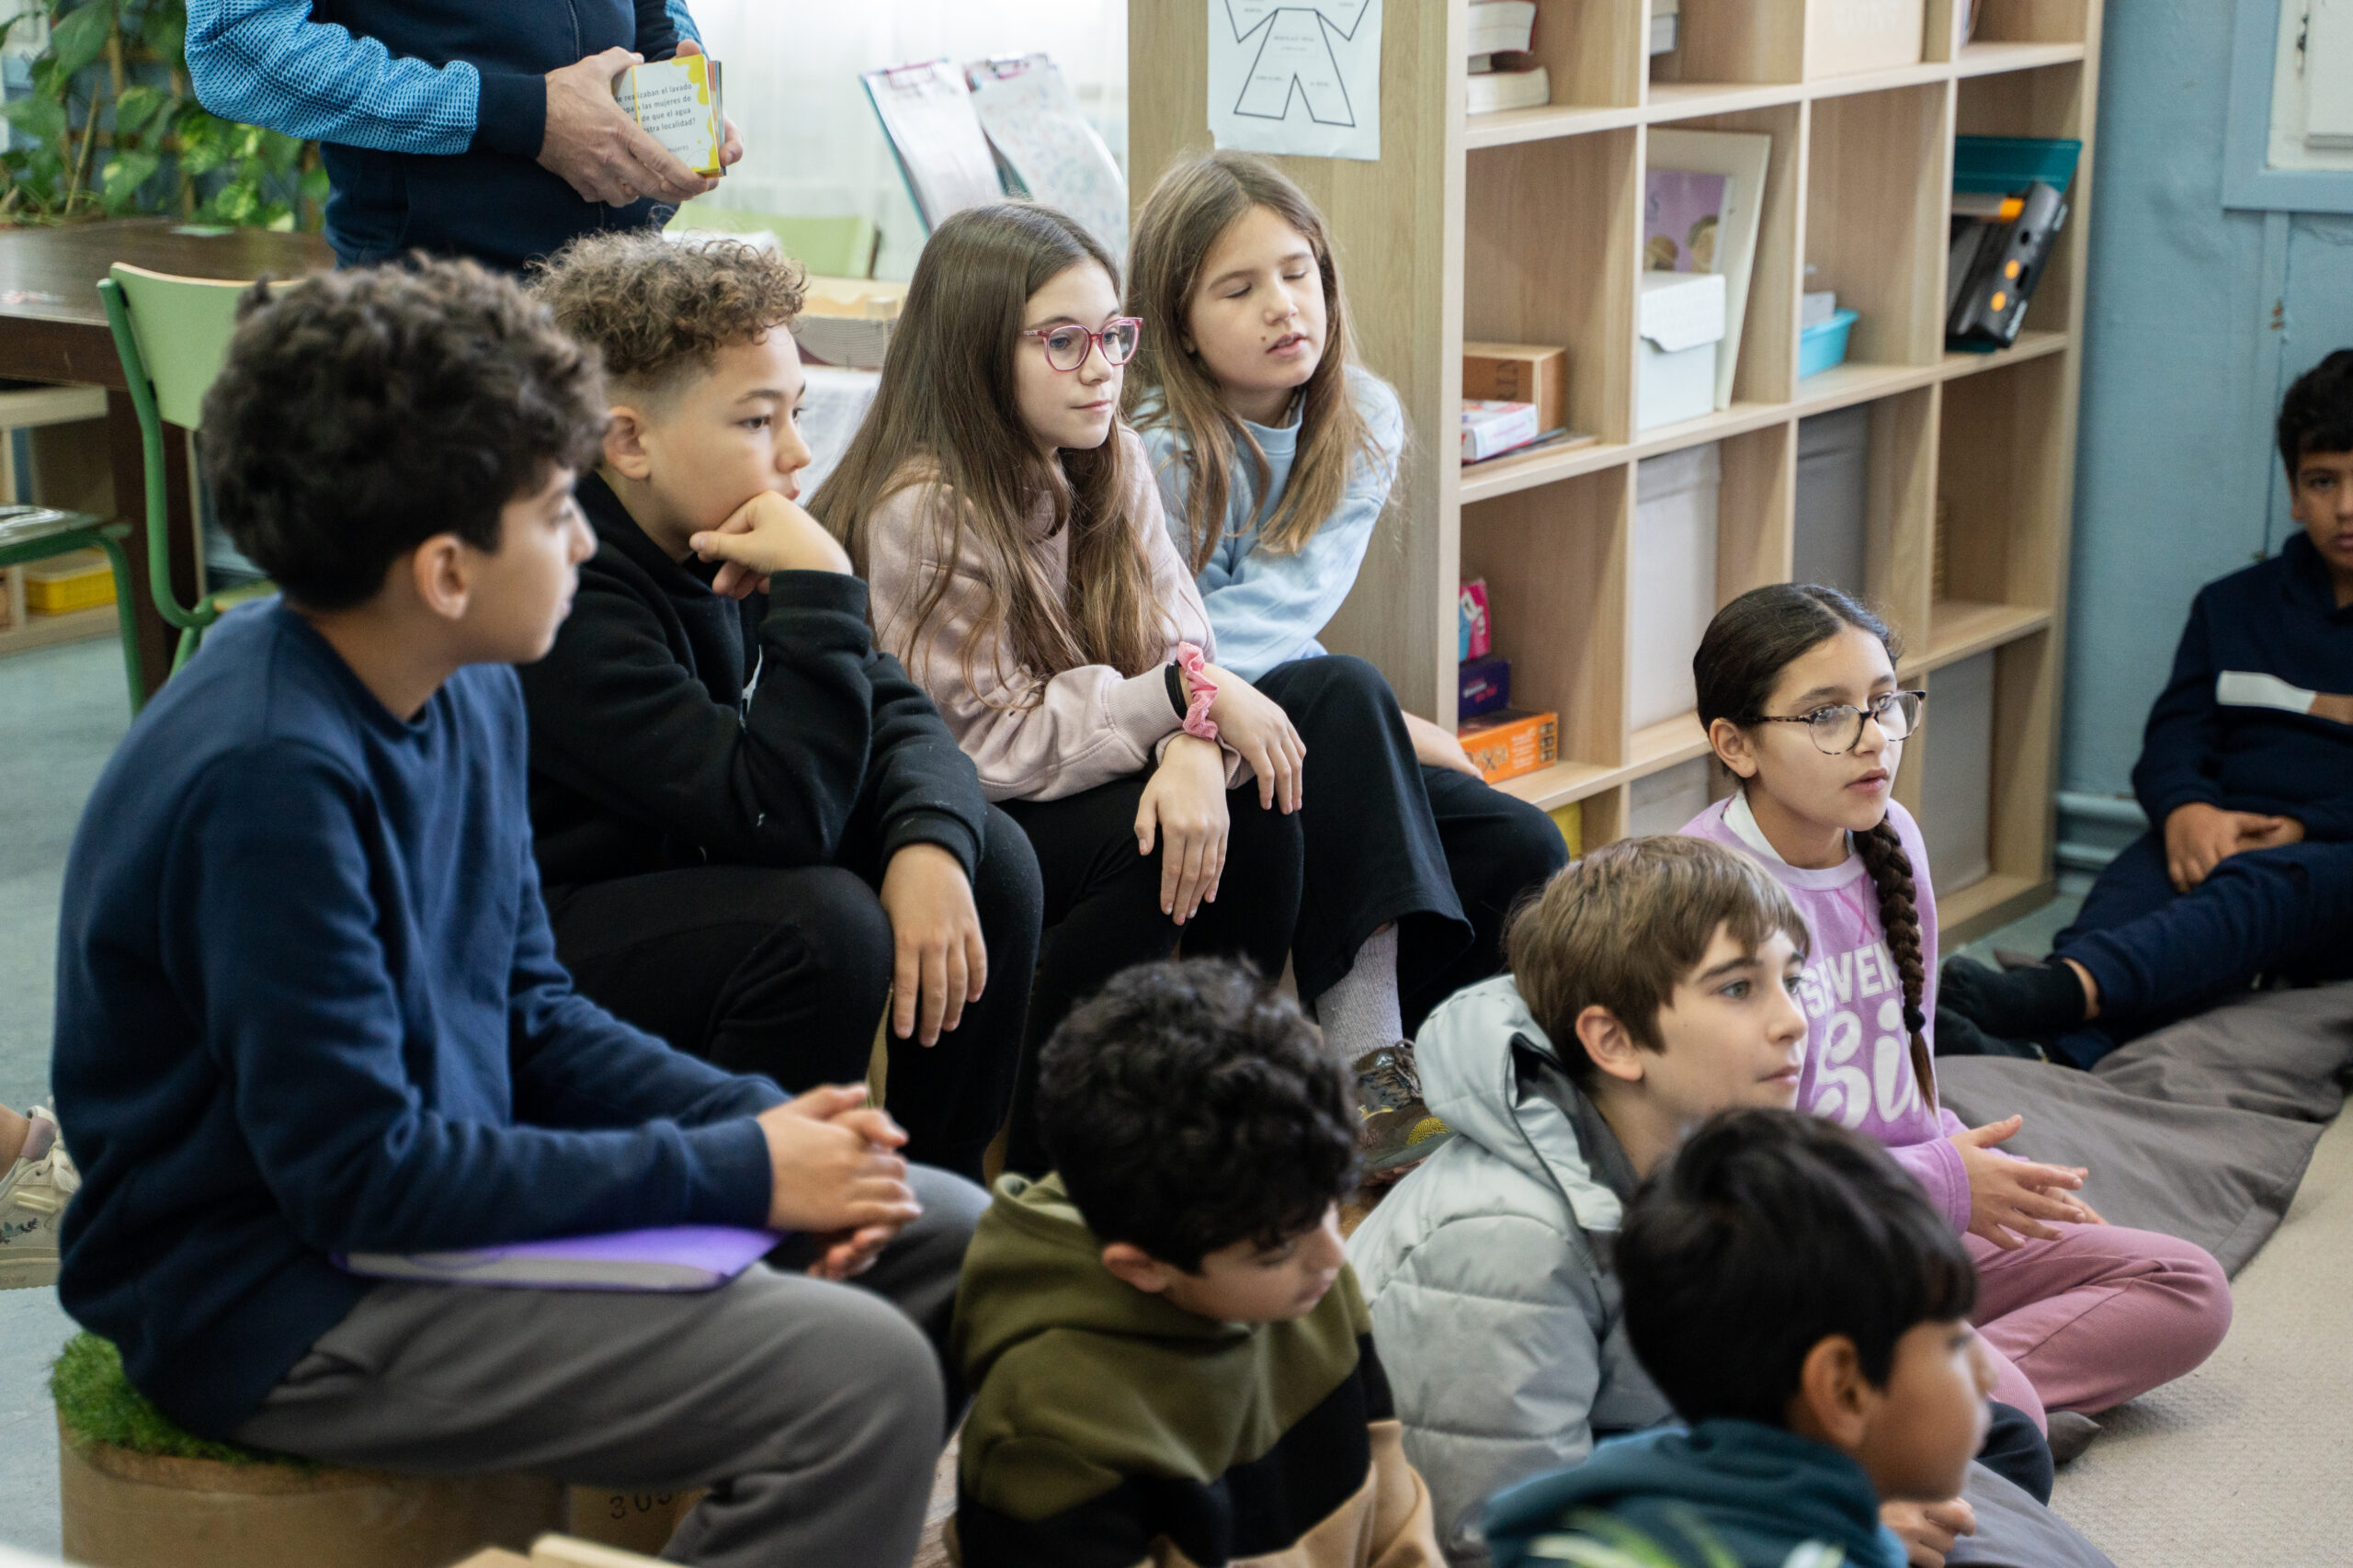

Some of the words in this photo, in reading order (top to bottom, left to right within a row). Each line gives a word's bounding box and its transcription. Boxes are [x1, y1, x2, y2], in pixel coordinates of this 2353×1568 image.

[624, 90, 659, 100] reaizaban
[669, 84, 692, 92] lavado
[654, 98, 681, 108] mujeres
[652, 111, 665, 120] que
[666, 109, 673, 118] el
[675, 108, 691, 117] agua
[662, 118, 696, 131] localidad?
